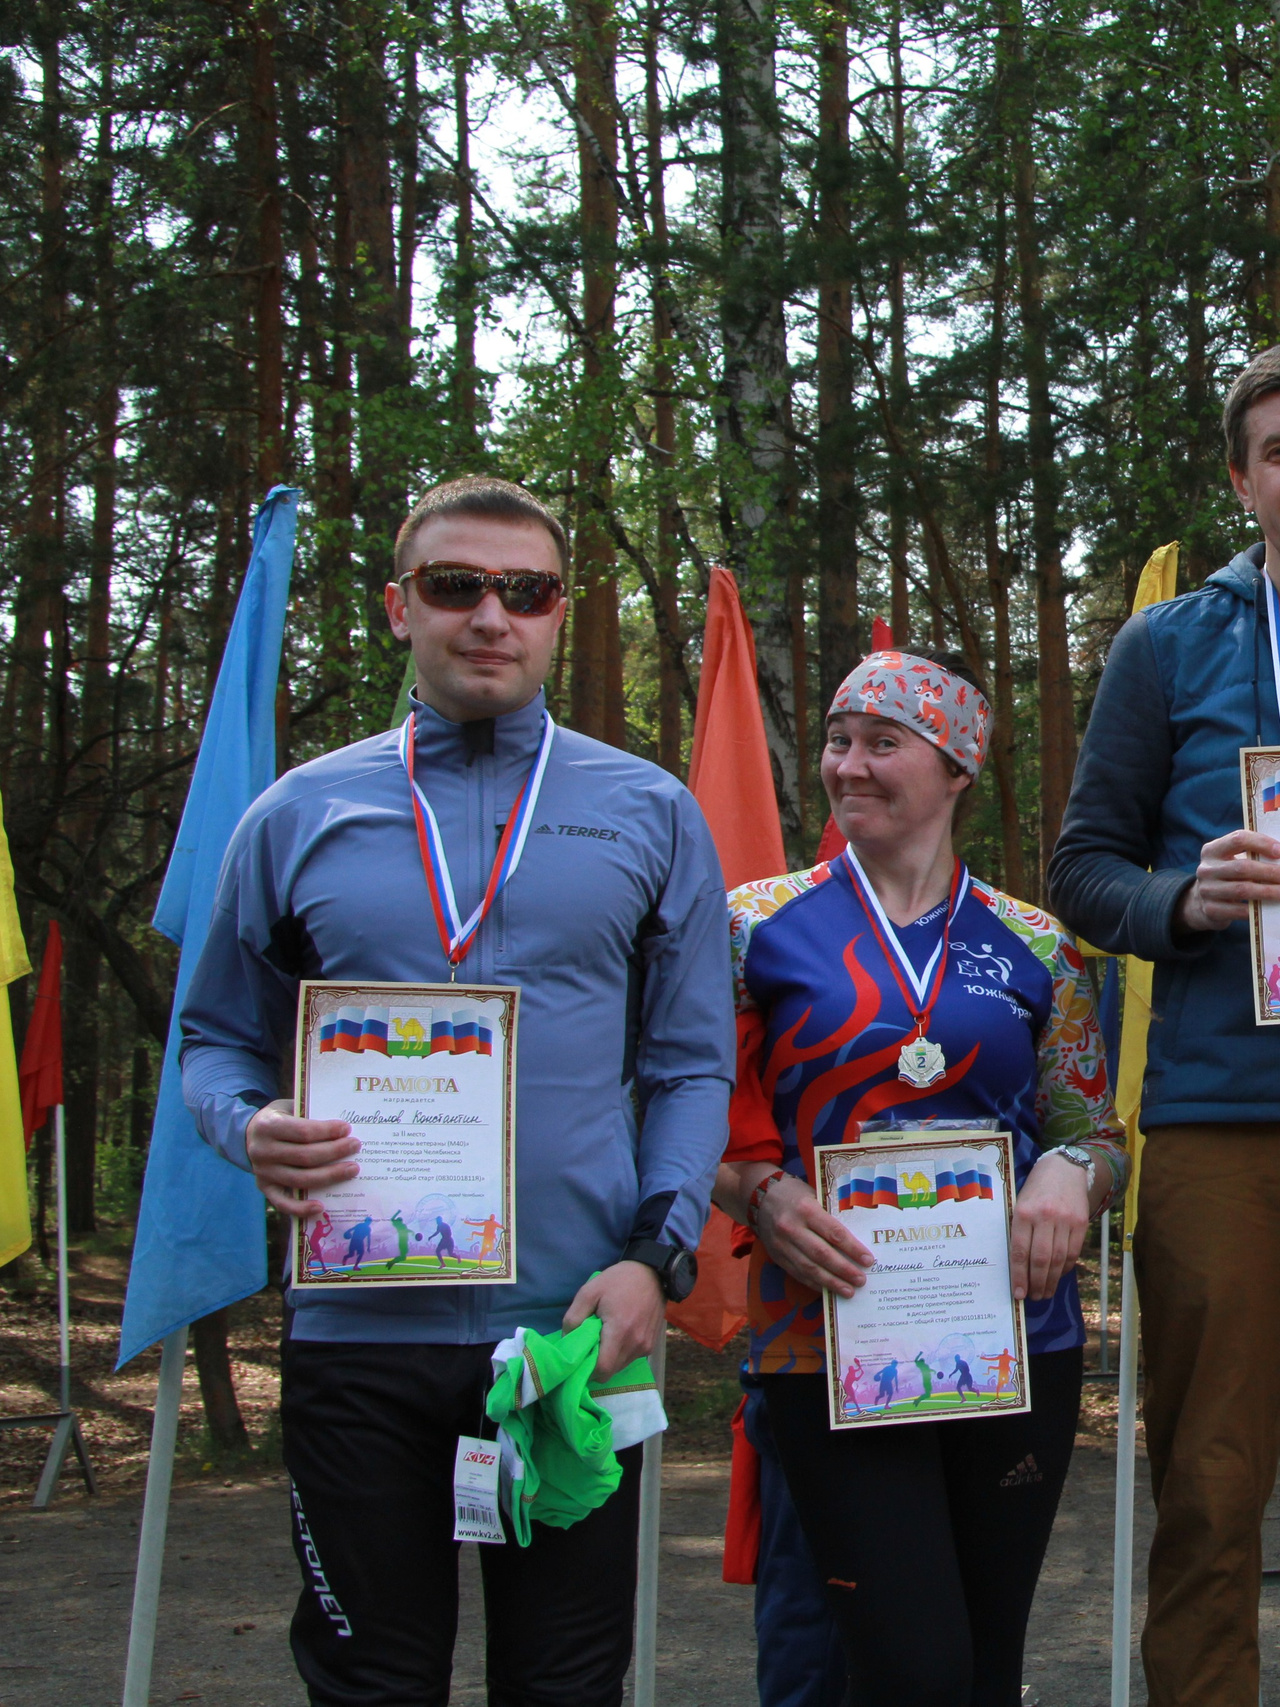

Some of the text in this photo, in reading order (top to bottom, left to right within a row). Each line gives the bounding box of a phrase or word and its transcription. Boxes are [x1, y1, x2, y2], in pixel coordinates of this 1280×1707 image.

[558, 825, 621, 842] TERREX
[914, 902, 949, 926] Южны
[917, 1057, 926, 1068] 2
[355, 1076, 459, 1092] ГРАМОТА
[872, 1222, 966, 1244] ГРАМОТА
[898, 1243, 945, 1252] награждается
[931, 1282, 959, 1290] ветераны
[883, 1294, 916, 1303] Первенстве
[938, 1289, 972, 1298] Челябинска
[886, 1302, 924, 1311] спортивному
[925, 1298, 974, 1308] ориентированию
[911, 1308, 946, 1317] дисциплине
[914, 1317, 934, 1325] общий
[1000, 1472, 1043, 1487] adidas
[458, 1529, 502, 1539] www.kv2.ch
